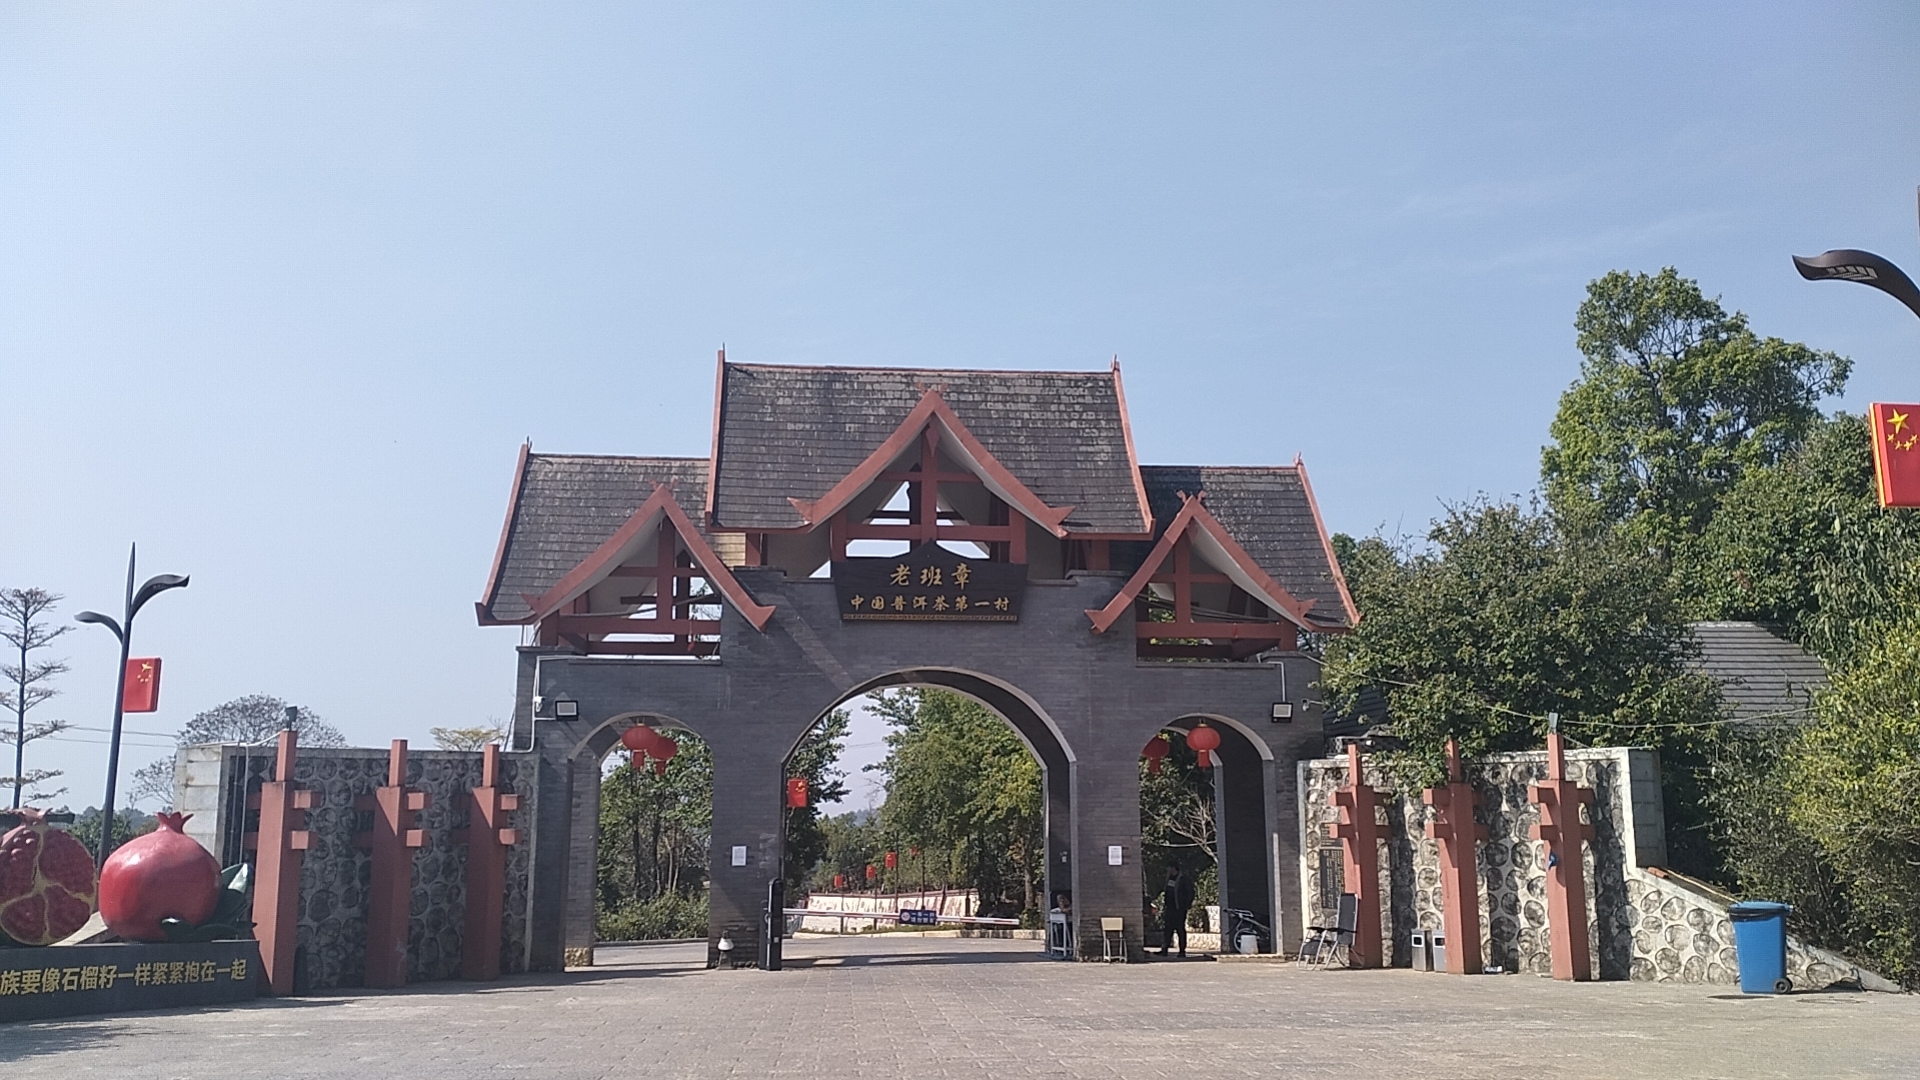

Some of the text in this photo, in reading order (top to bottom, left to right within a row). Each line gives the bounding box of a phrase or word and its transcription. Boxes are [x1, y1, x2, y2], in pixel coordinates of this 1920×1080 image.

[890, 562, 972, 590] 老班章
[851, 594, 1010, 612] 中国普洱茶第一村
[0, 958, 248, 996] 族要像石榴籽一样紧紧抱在一起
